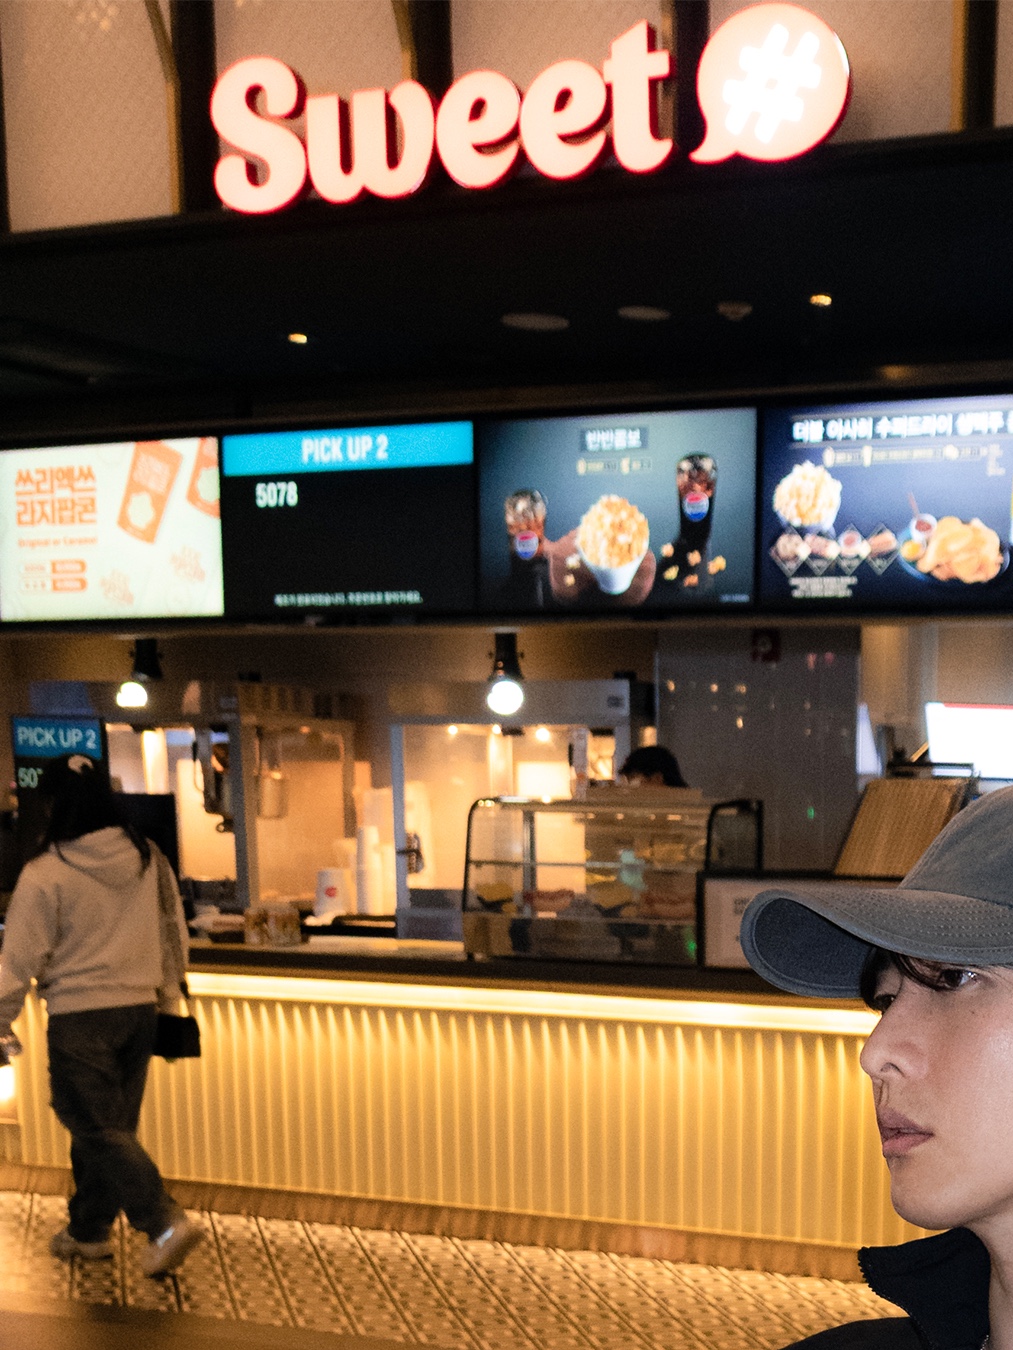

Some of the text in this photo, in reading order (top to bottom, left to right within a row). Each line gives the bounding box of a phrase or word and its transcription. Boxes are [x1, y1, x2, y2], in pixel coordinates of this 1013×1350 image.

[211, 19, 673, 214] Sweet
[585, 428, 642, 452] 반반콤보
[793, 420, 824, 443] 더블
[826, 417, 873, 442] 아사히
[301, 433, 389, 464] PICK UP 2
[255, 481, 298, 508] 5078
[16, 497, 97, 527] 라지팝콘
[17, 726, 97, 750] PICK UP 2
